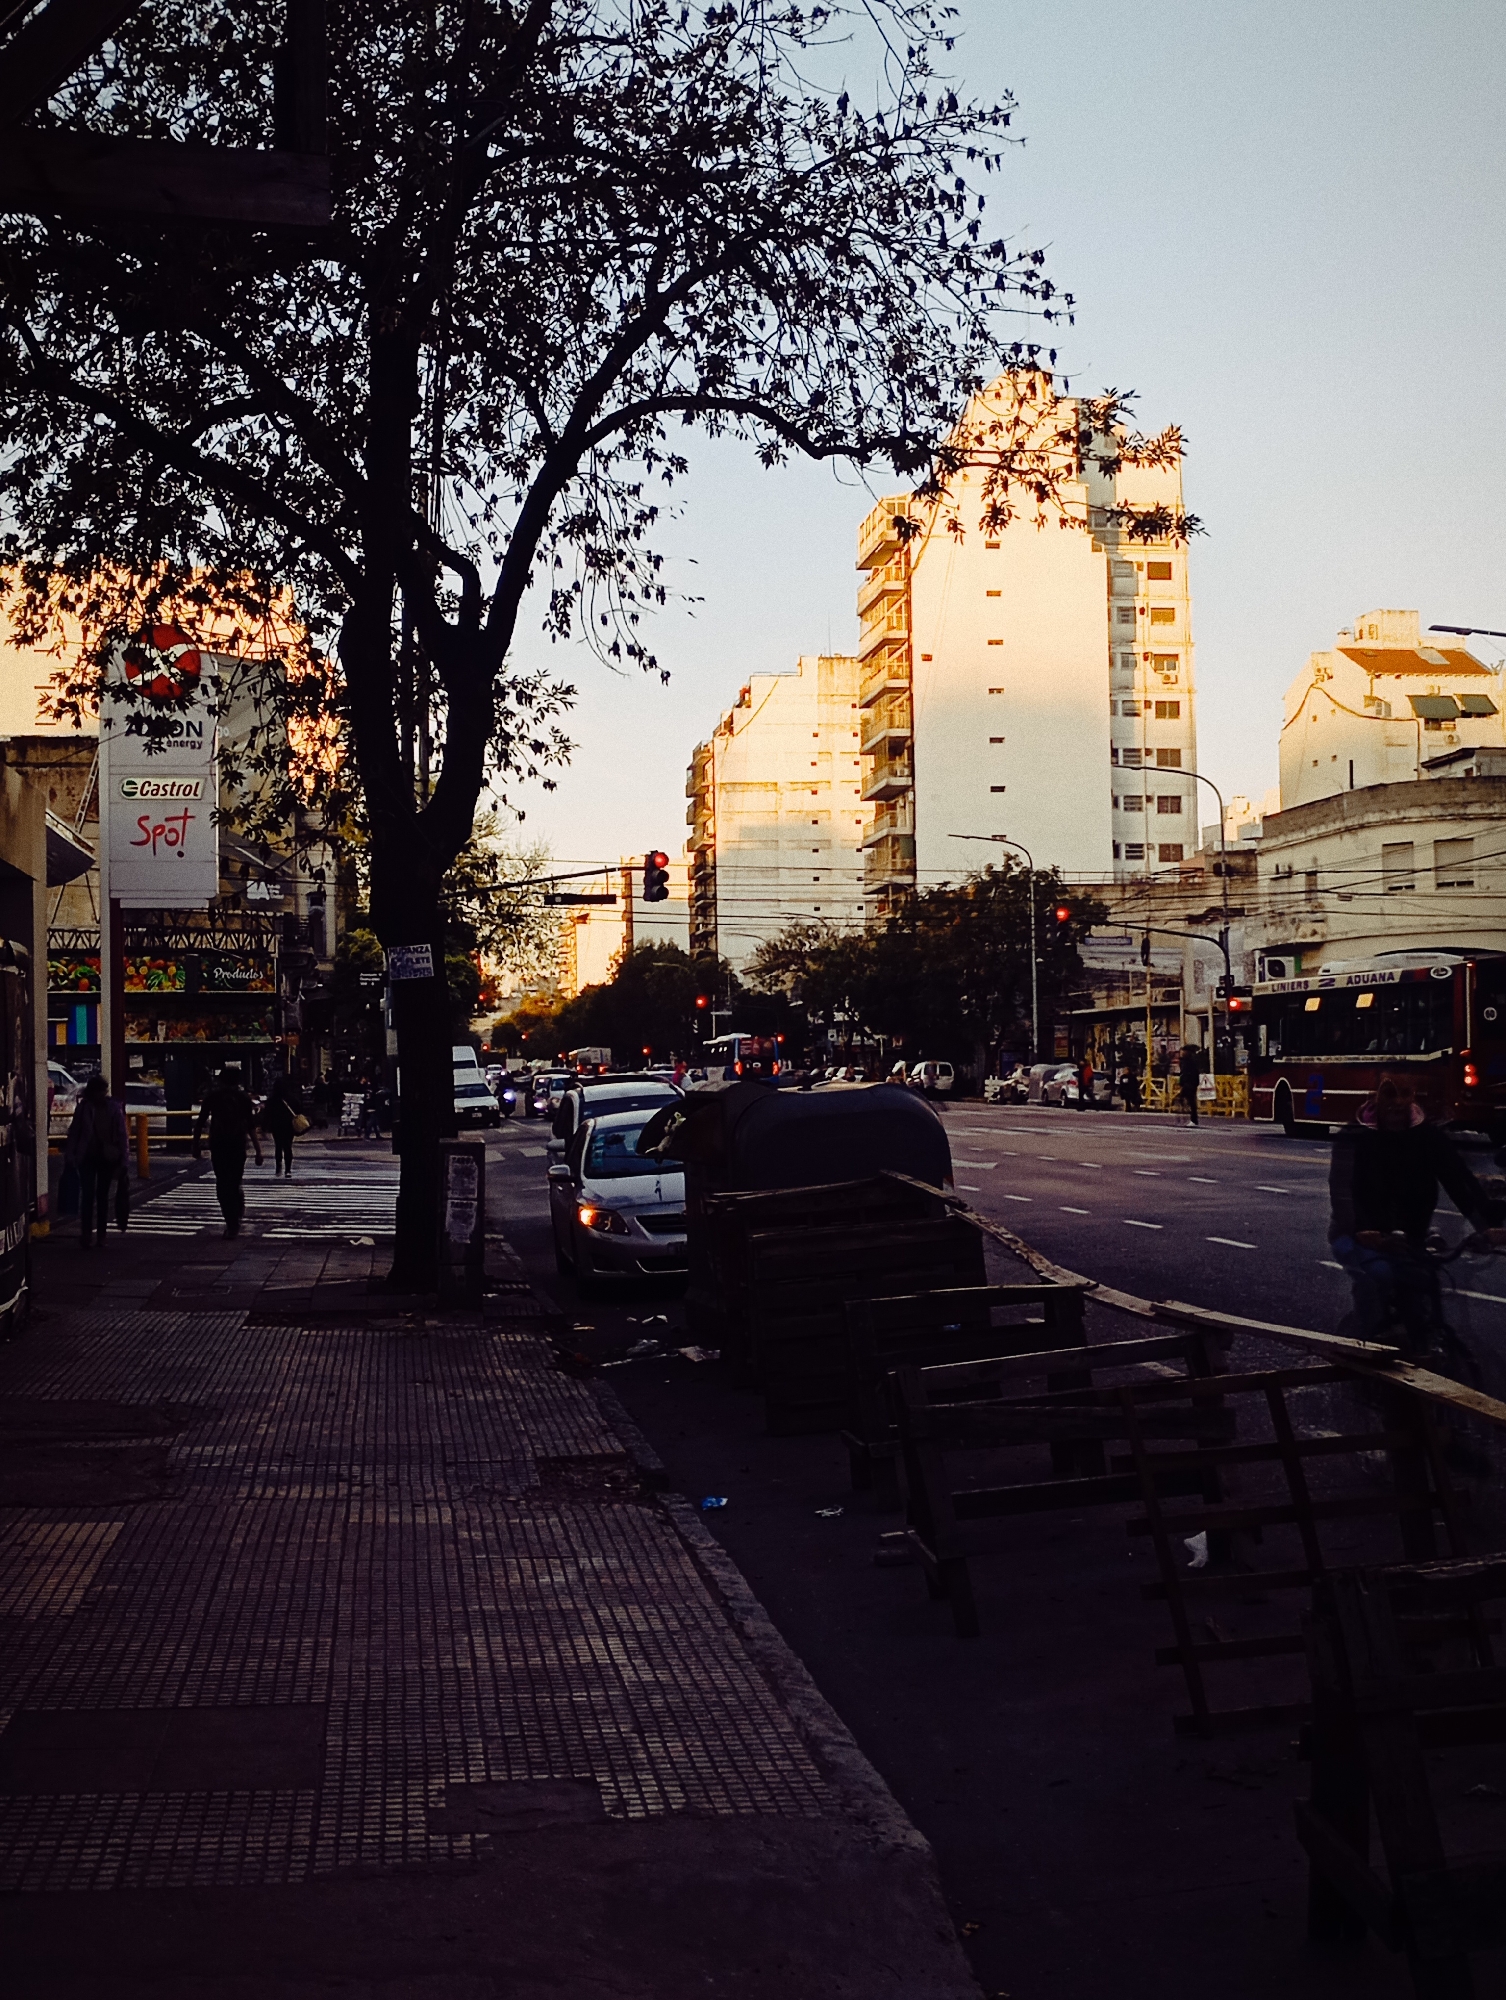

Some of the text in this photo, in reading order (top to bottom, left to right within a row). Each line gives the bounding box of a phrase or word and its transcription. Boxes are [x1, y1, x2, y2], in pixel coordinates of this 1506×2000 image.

[125, 720, 203, 737] AON
[166, 740, 203, 749] energy
[140, 780, 200, 797] Castrol
[213, 967, 264, 980] Productos
[1271, 971, 1395, 993] LINIERS 2 ADUANA
